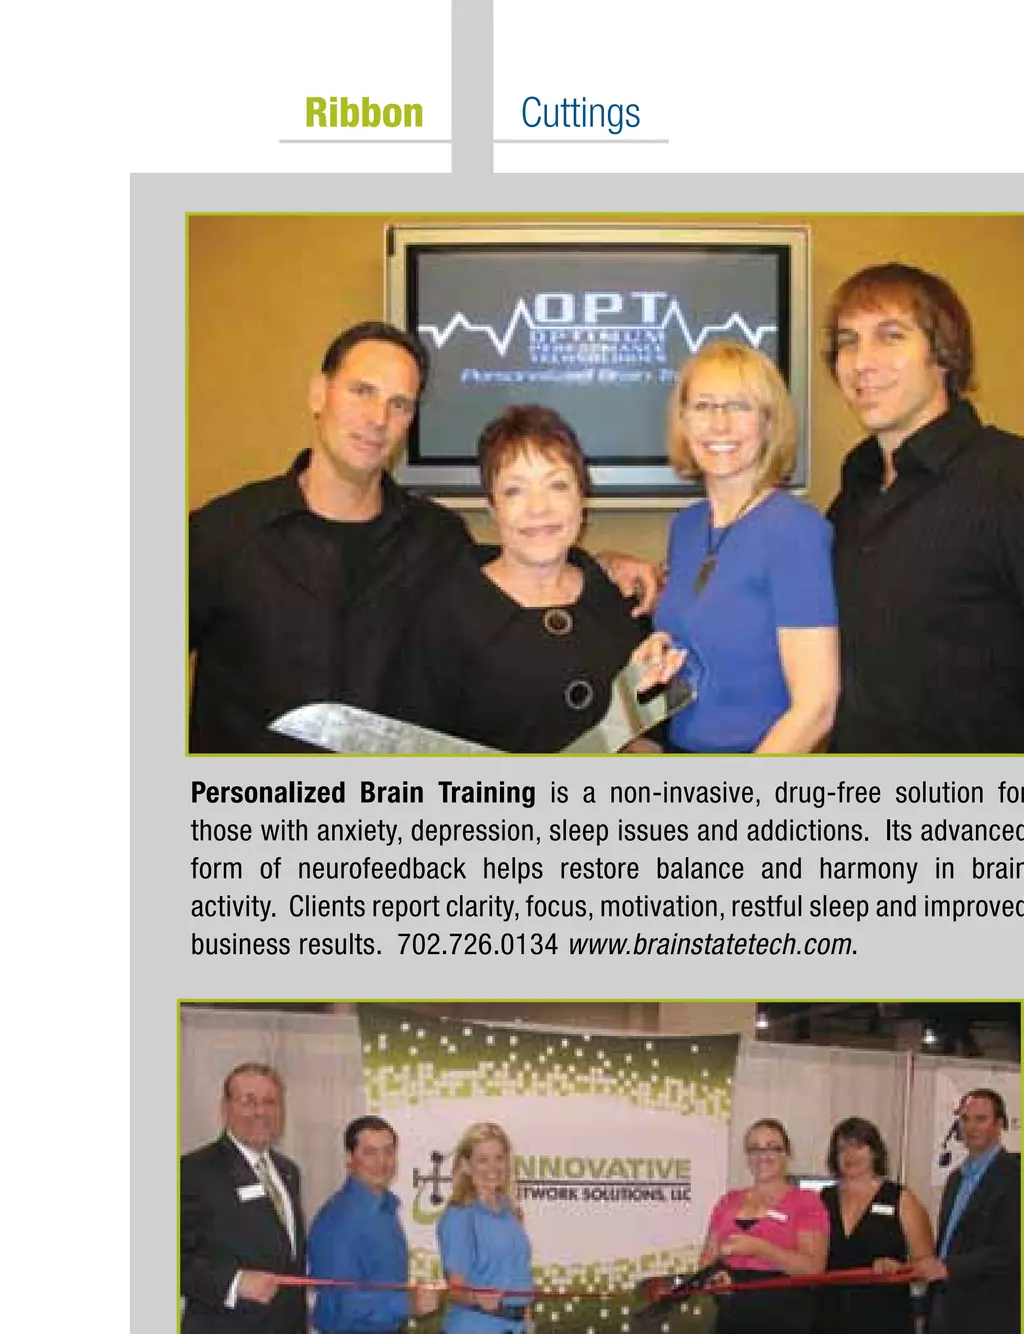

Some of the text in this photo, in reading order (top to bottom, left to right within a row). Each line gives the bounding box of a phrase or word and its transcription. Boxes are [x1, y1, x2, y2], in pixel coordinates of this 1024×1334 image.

[306, 96, 423, 128] Ribbon
[522, 96, 640, 134] Cuttings
[534, 292, 667, 323] OPT
[192, 781, 345, 803] Personalized
[361, 781, 423, 803] Brain
[438, 781, 535, 808] Training
[552, 781, 568, 803] is
[583, 786, 596, 803] a
[611, 781, 760, 807] non-invasive,
[775, 781, 880, 808] drug-free
[896, 781, 983, 803] solution
[192, 895, 275, 922] activity.
[290, 895, 365, 917] Clients
[373, 896, 440, 922] report
[447, 895, 519, 922] clarity,
[526, 895, 592, 920] focus,
[601, 895, 724, 921] motivation,
[733, 895, 801, 917] restful
[810, 895, 869, 922] sleep
[876, 895, 916, 917] and
[192, 933, 856, 955] business results. 702.726.0134 www.brainstatetech.com.
[513, 1154, 692, 1179] NNOVATIVE
